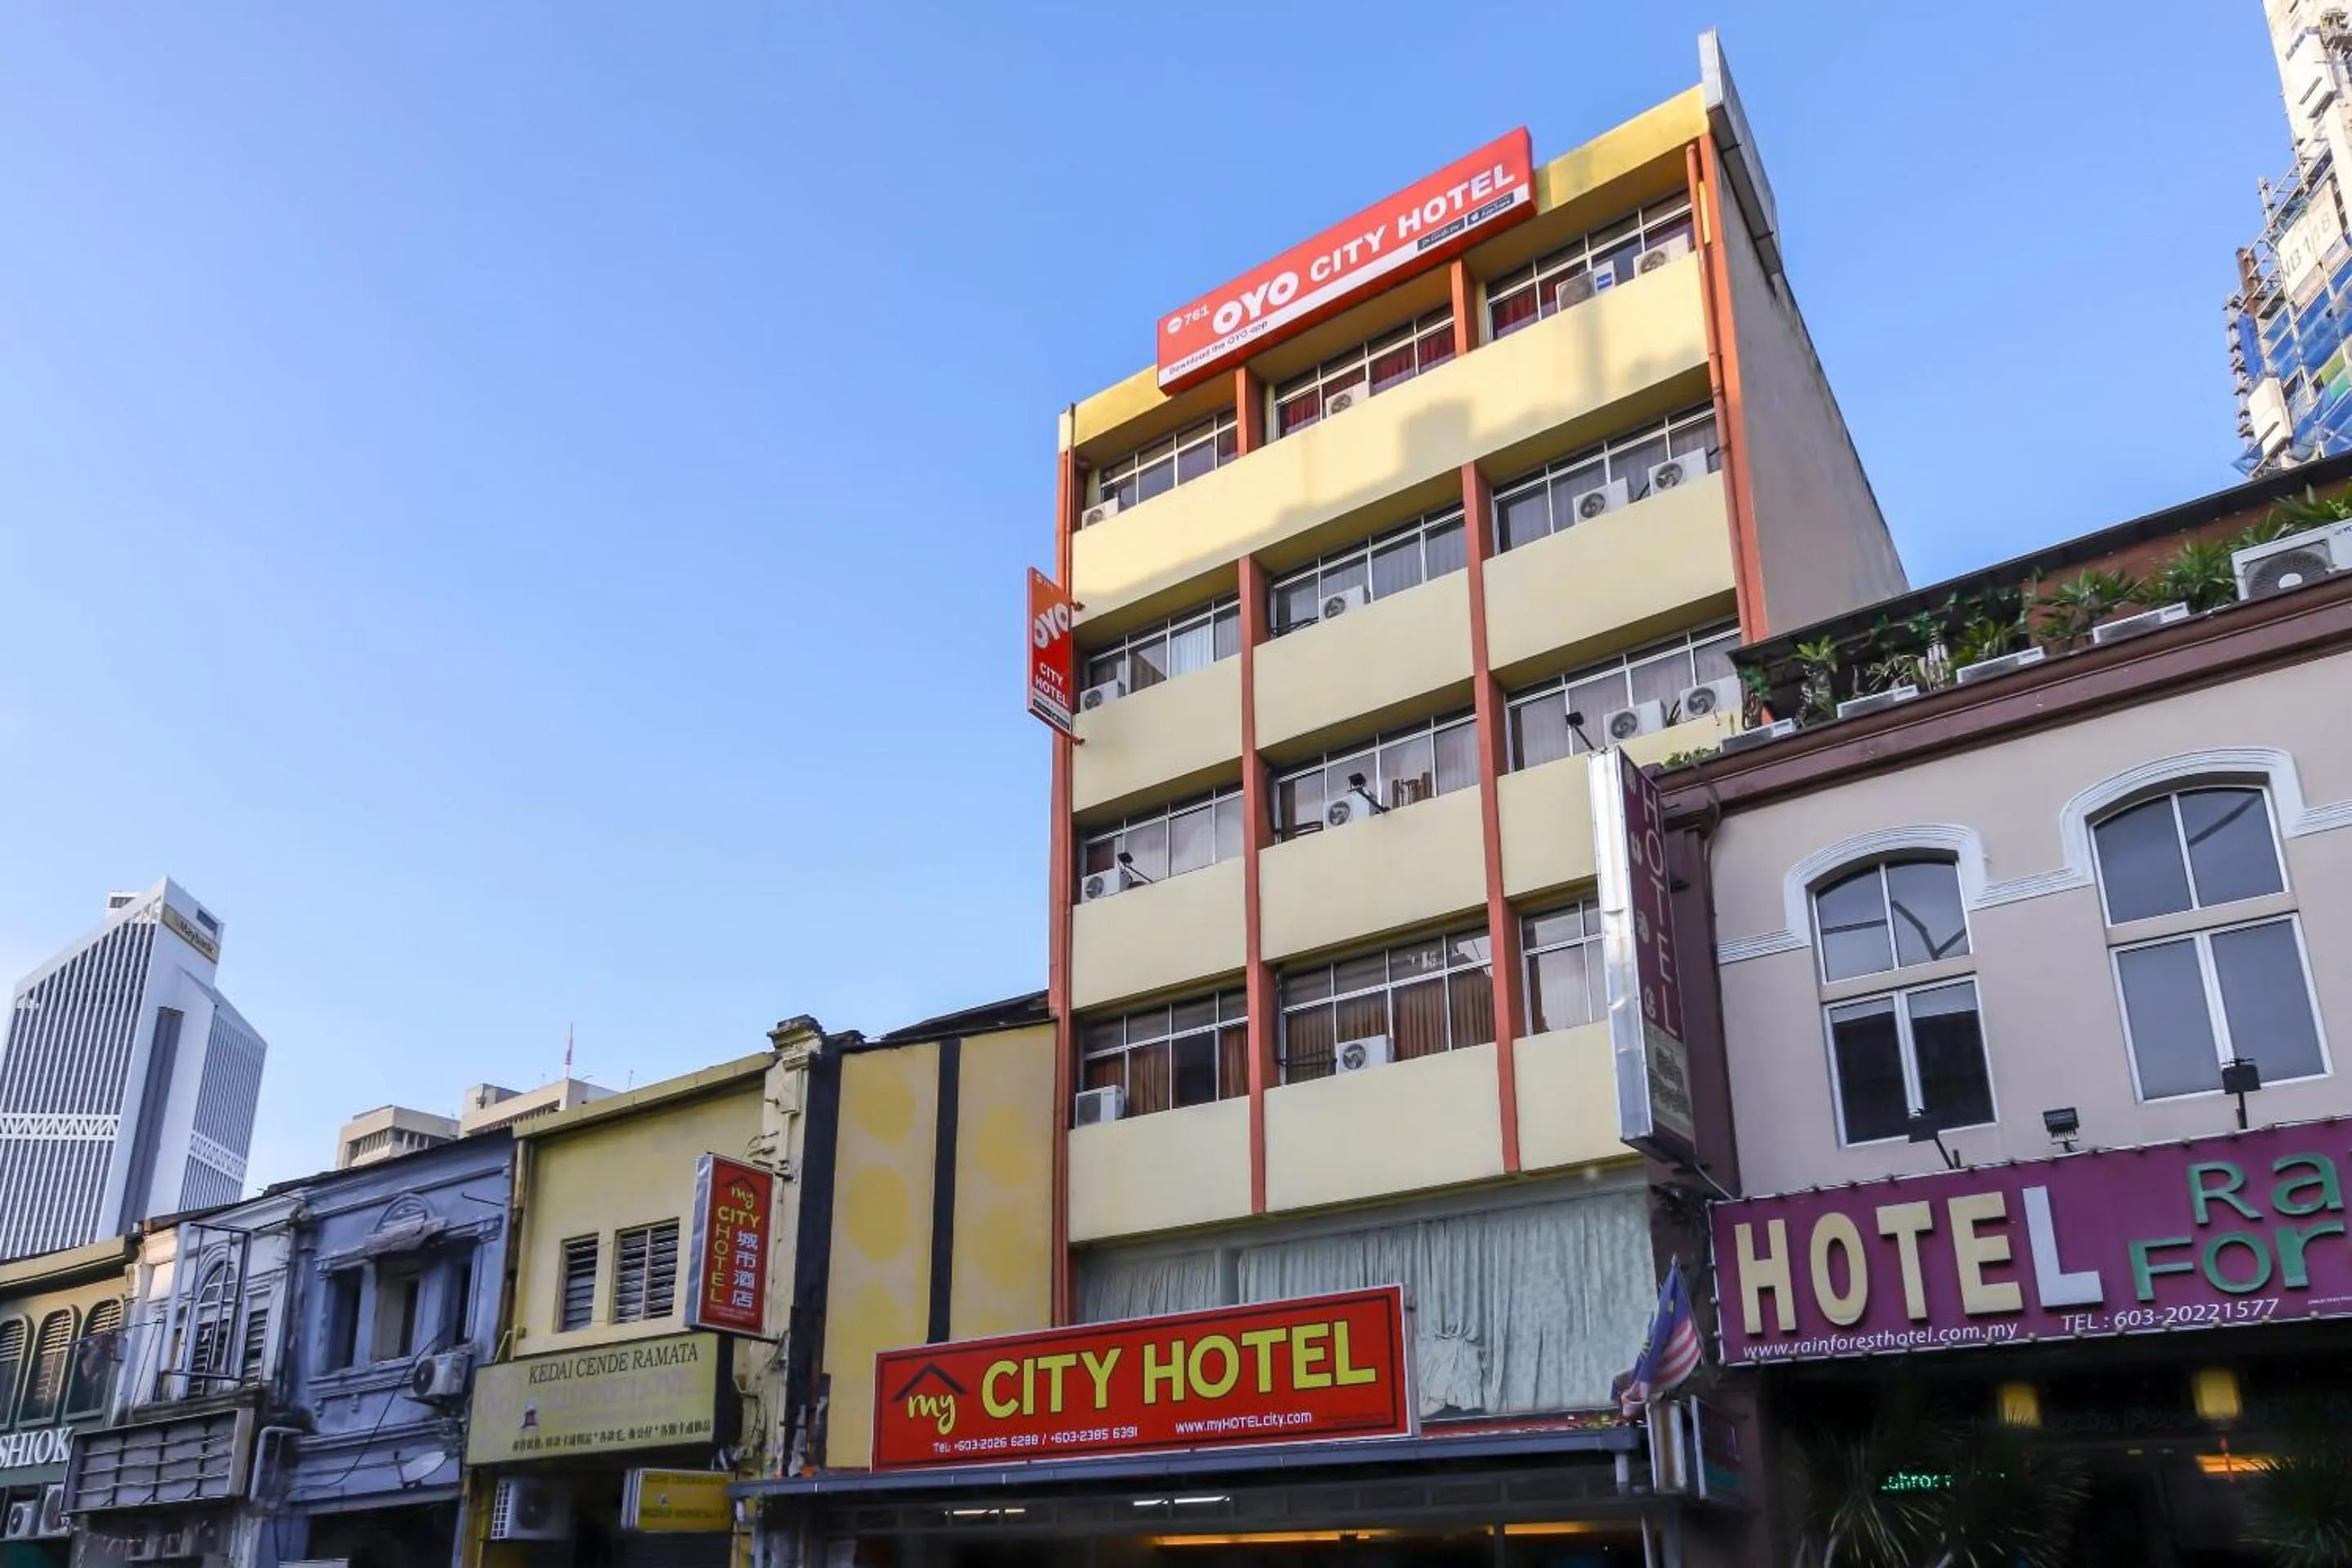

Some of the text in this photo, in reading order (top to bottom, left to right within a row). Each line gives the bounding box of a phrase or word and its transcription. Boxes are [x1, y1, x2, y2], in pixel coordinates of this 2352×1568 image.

[1212, 271, 1299, 335] OYO
[1310, 224, 1387, 282] CITY
[1398, 163, 1515, 239] HOTEL
[1033, 602, 1069, 649] OYO
[1034, 675, 1069, 708] HOTEL
[1039, 662, 1064, 687] CITY
[1642, 778, 1678, 1036] HOTEL
[717, 1204, 761, 1229] CITY
[731, 1185, 755, 1209] my
[710, 1224, 731, 1303] HOTEL
[731, 1230, 759, 1309] 城市酒店
[1735, 1186, 2104, 1336] HOTEL
[2061, 1312, 2099, 1331] TEL
[2114, 1298, 2280, 1327] 603-20221577
[1742, 1322, 2018, 1359] www.rainforesthotel.com.my
[529, 1343, 698, 1384] KEDAI CENDE RAMATA
[907, 1320, 1377, 1435] my CITY HOTEL
